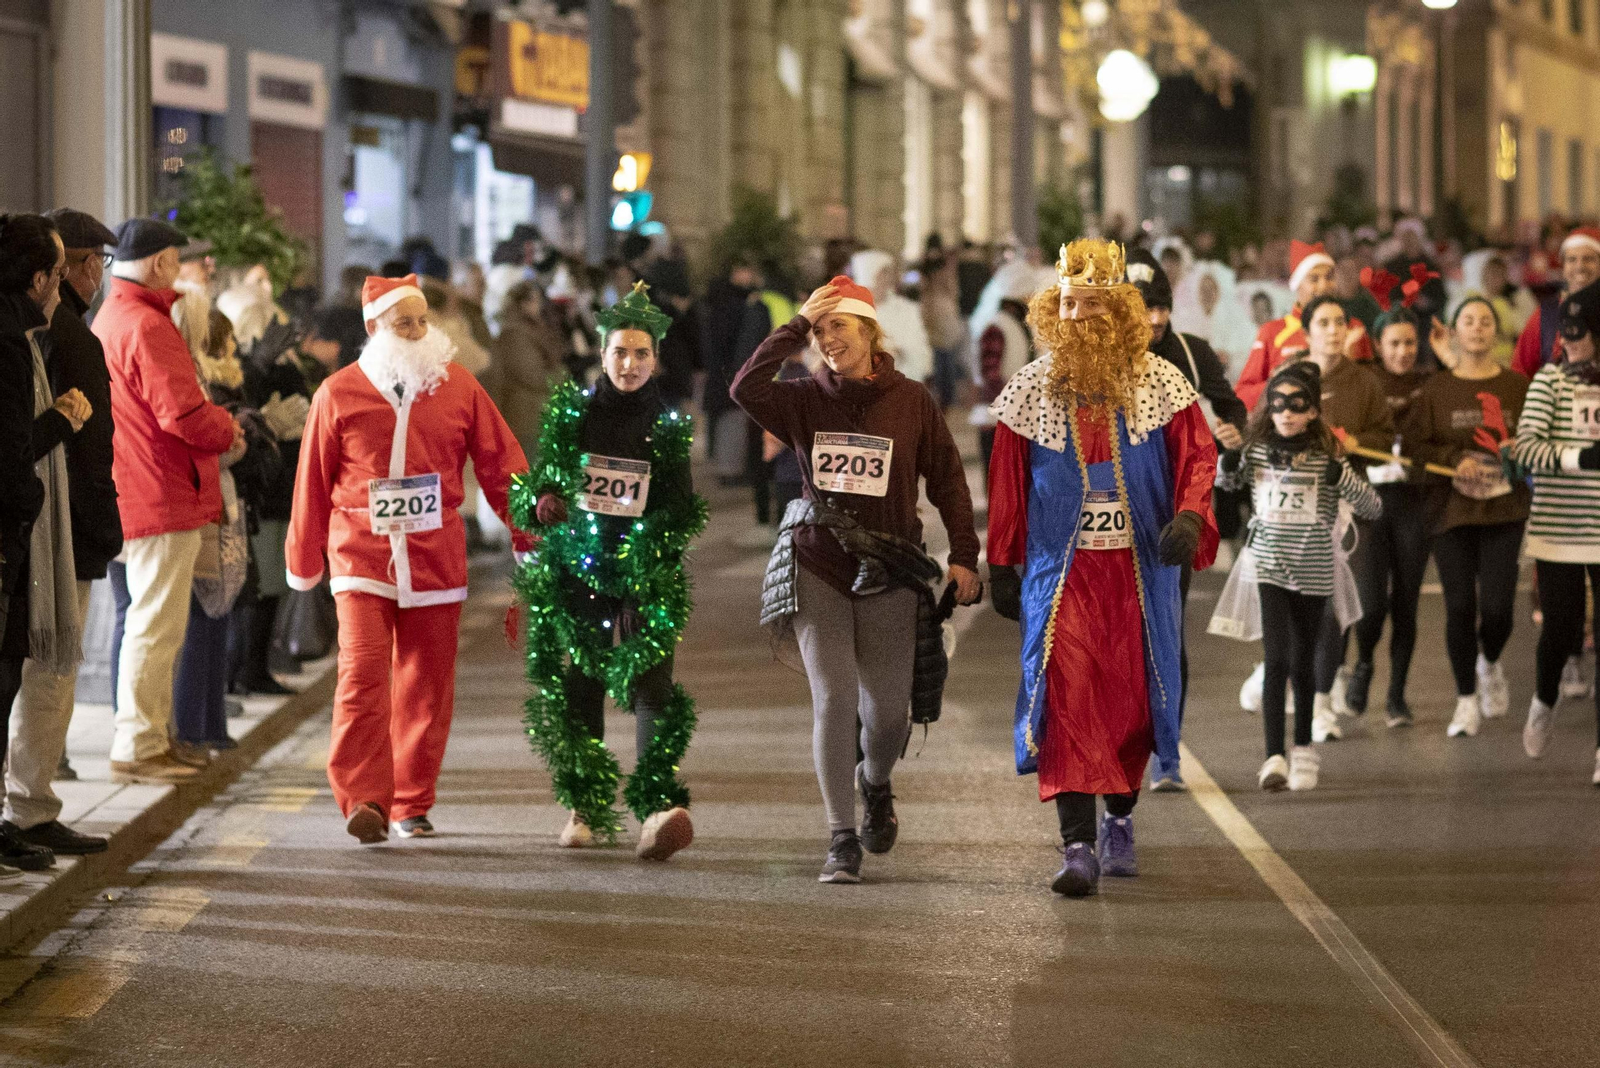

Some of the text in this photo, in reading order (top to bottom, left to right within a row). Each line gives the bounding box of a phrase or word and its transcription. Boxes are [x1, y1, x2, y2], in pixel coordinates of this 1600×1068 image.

[817, 452, 885, 479] 2203
[582, 473, 641, 501] 2201
[376, 494, 437, 518] 2202
[1081, 510, 1126, 532] 220
